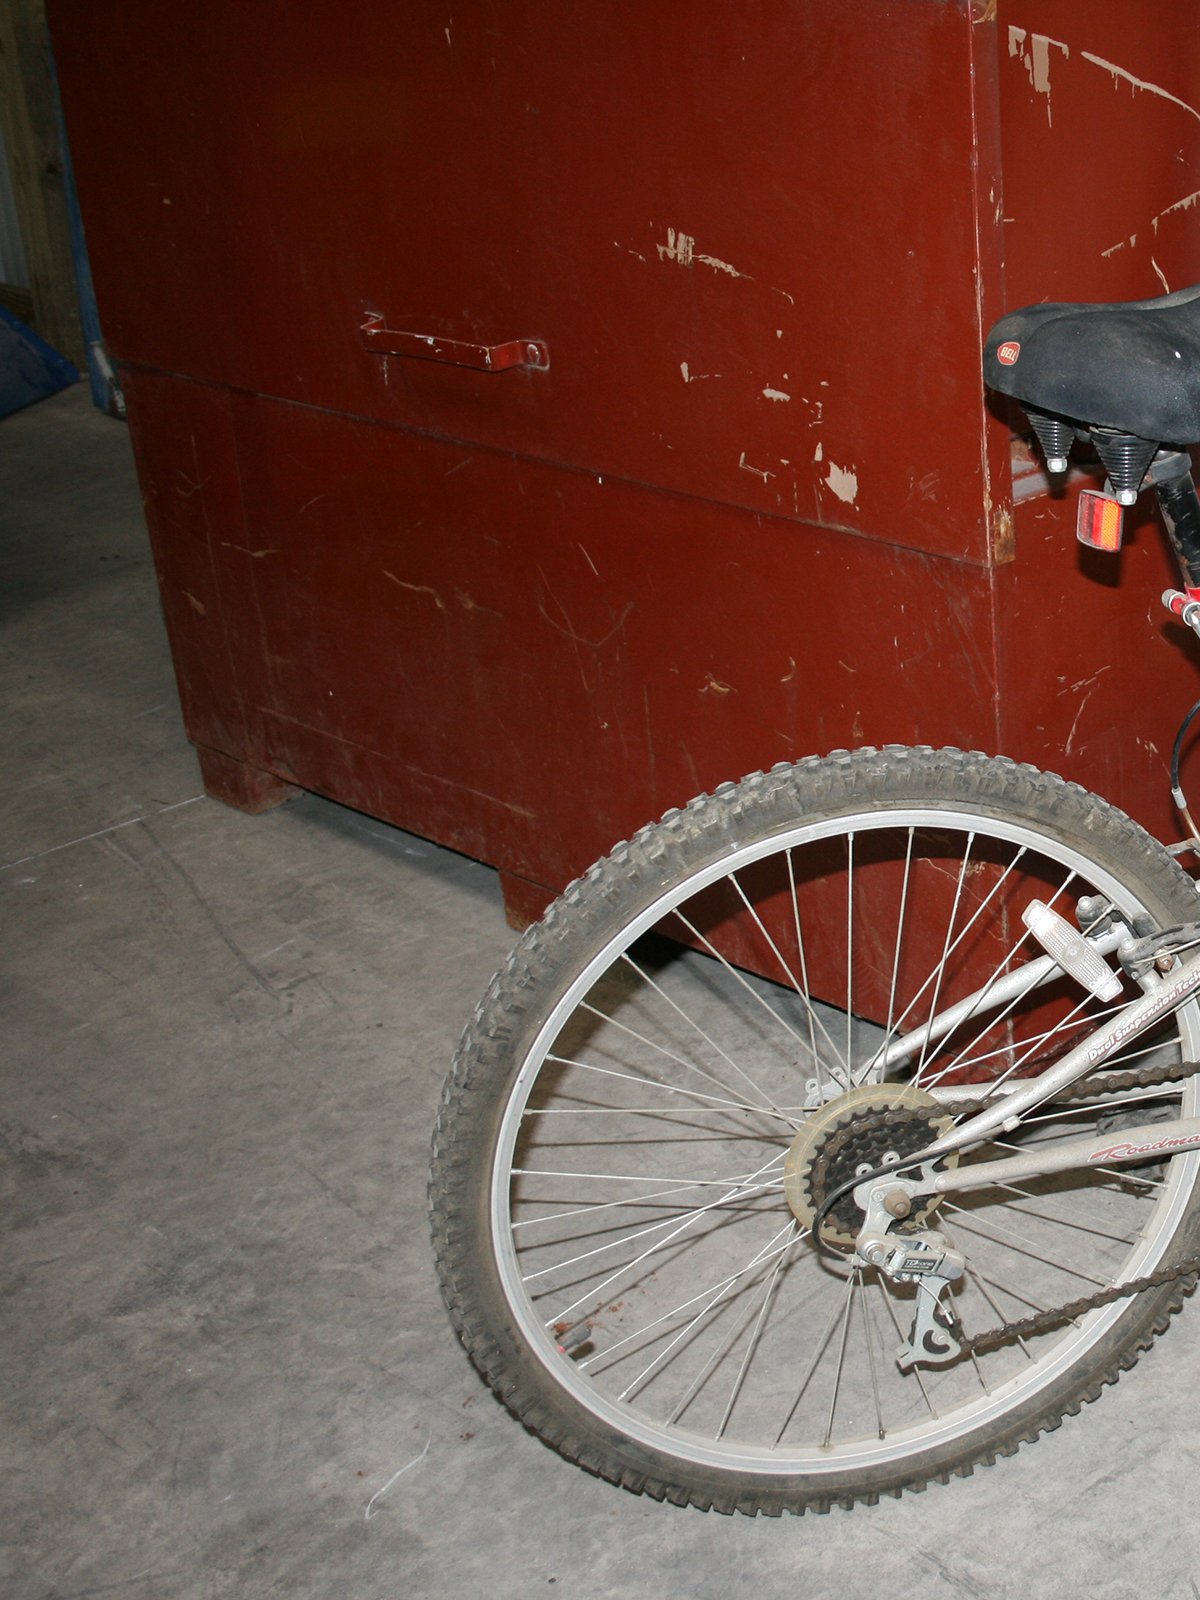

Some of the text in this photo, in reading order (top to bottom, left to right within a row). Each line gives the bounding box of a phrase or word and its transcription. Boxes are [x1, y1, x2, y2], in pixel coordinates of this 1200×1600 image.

[1000, 346, 1017, 362] BELL
[1088, 1037, 1115, 1062] Dual
[1114, 990, 1177, 1042] Suspension
